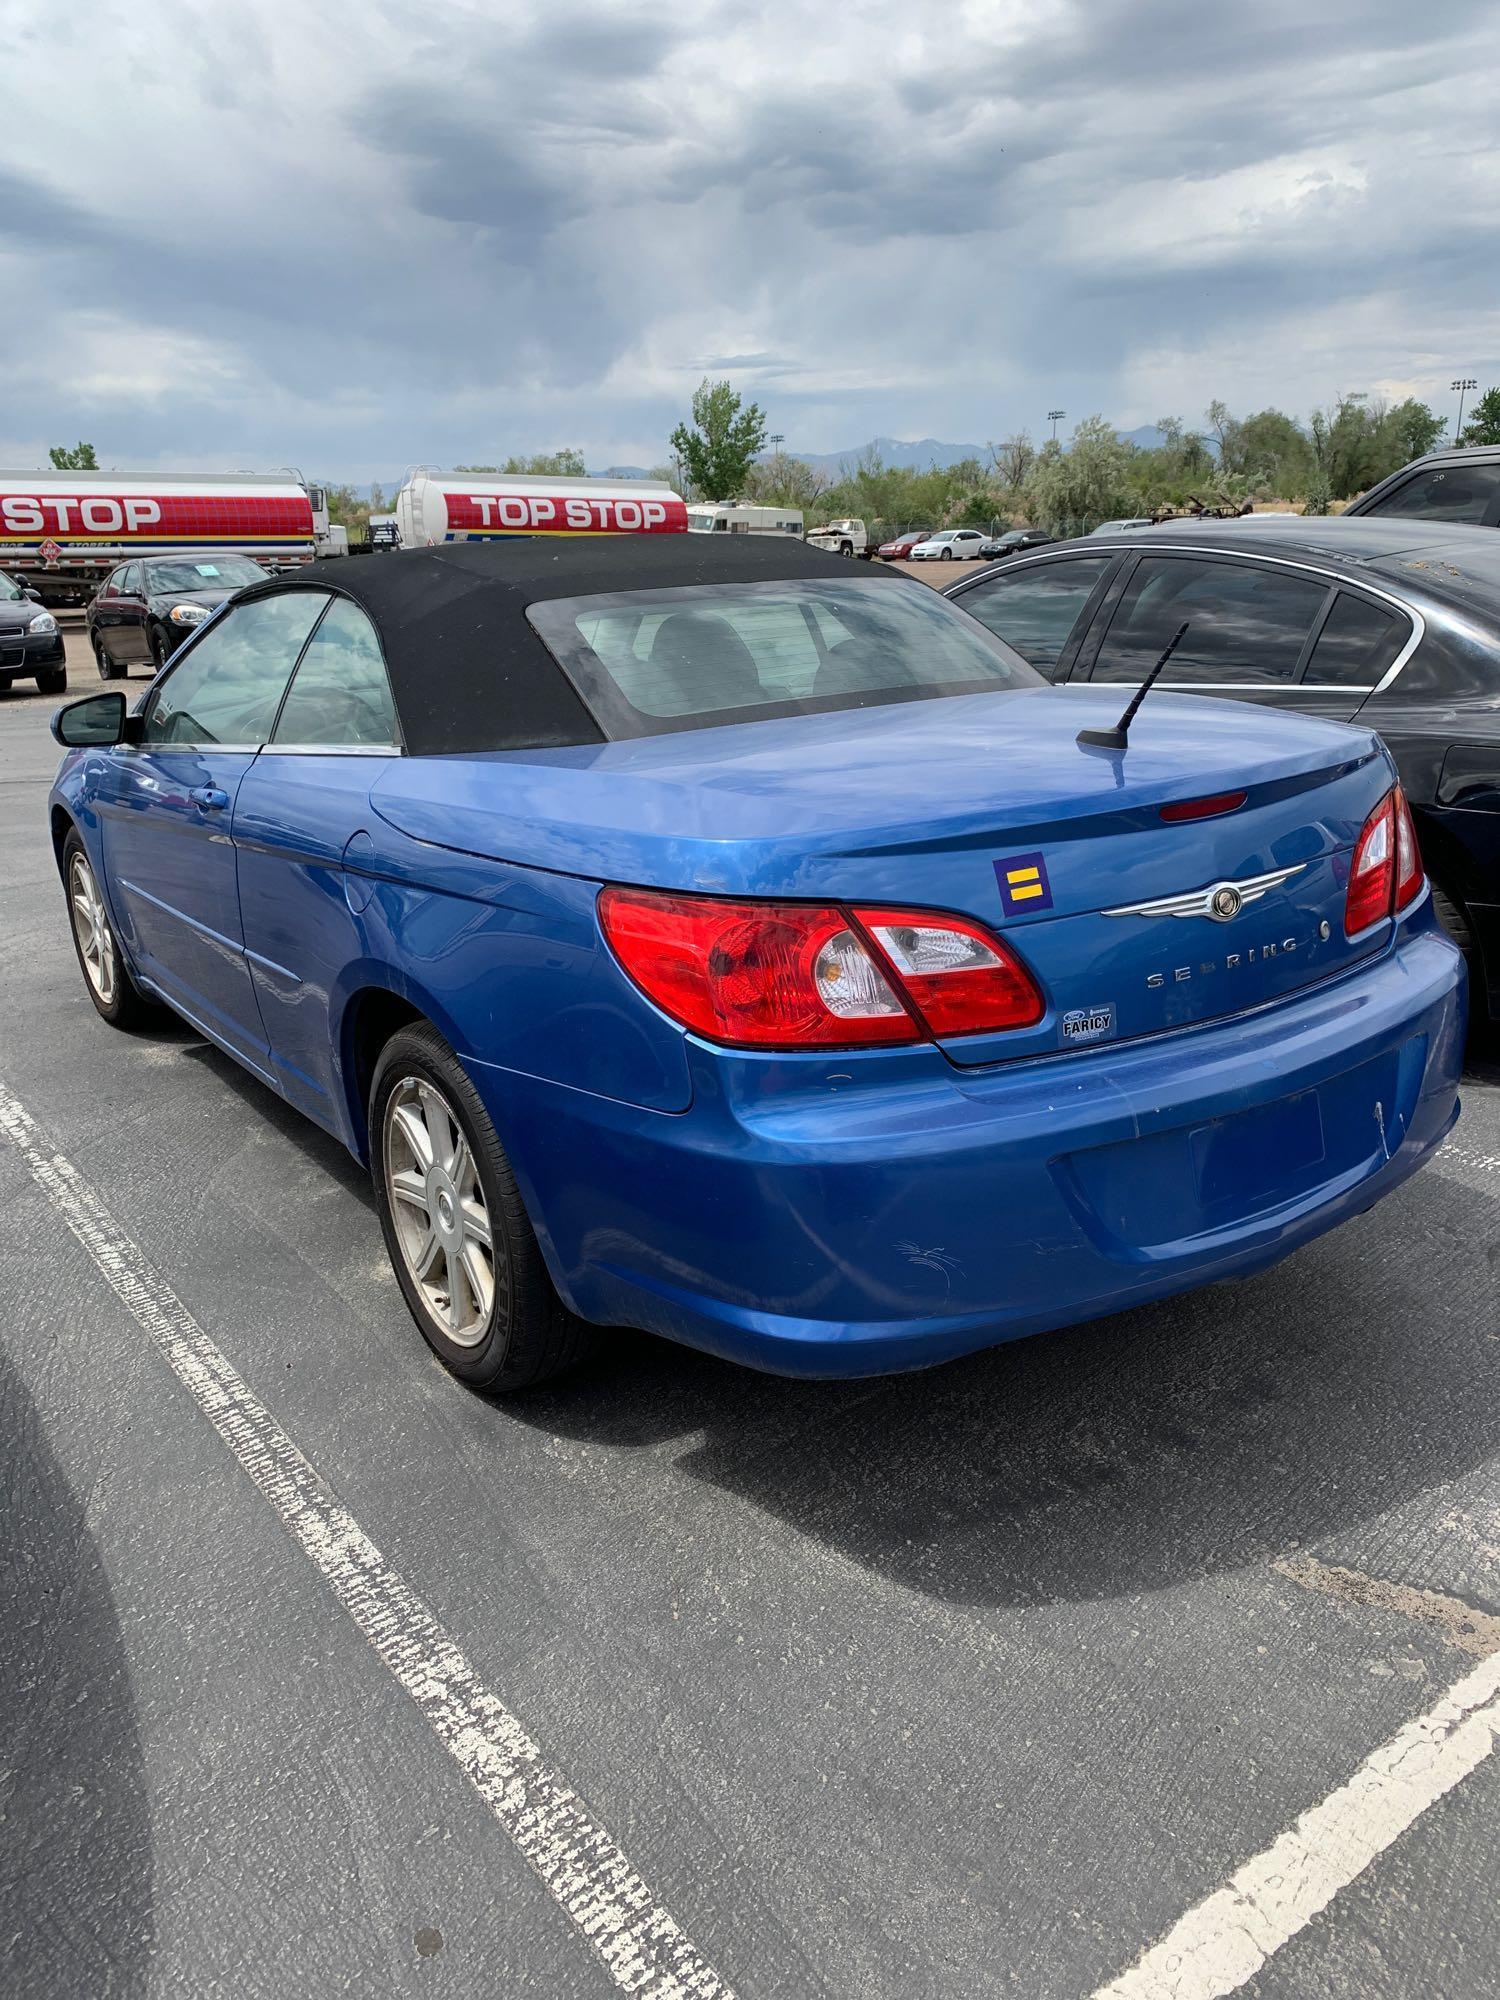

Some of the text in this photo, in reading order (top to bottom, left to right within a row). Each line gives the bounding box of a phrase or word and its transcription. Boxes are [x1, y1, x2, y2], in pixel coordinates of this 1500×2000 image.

[1, 497, 161, 532] STOP
[470, 496, 666, 530] TOP STOP
[1147, 938, 1297, 988] SERING
[1063, 1014, 1111, 1036] FARICY
